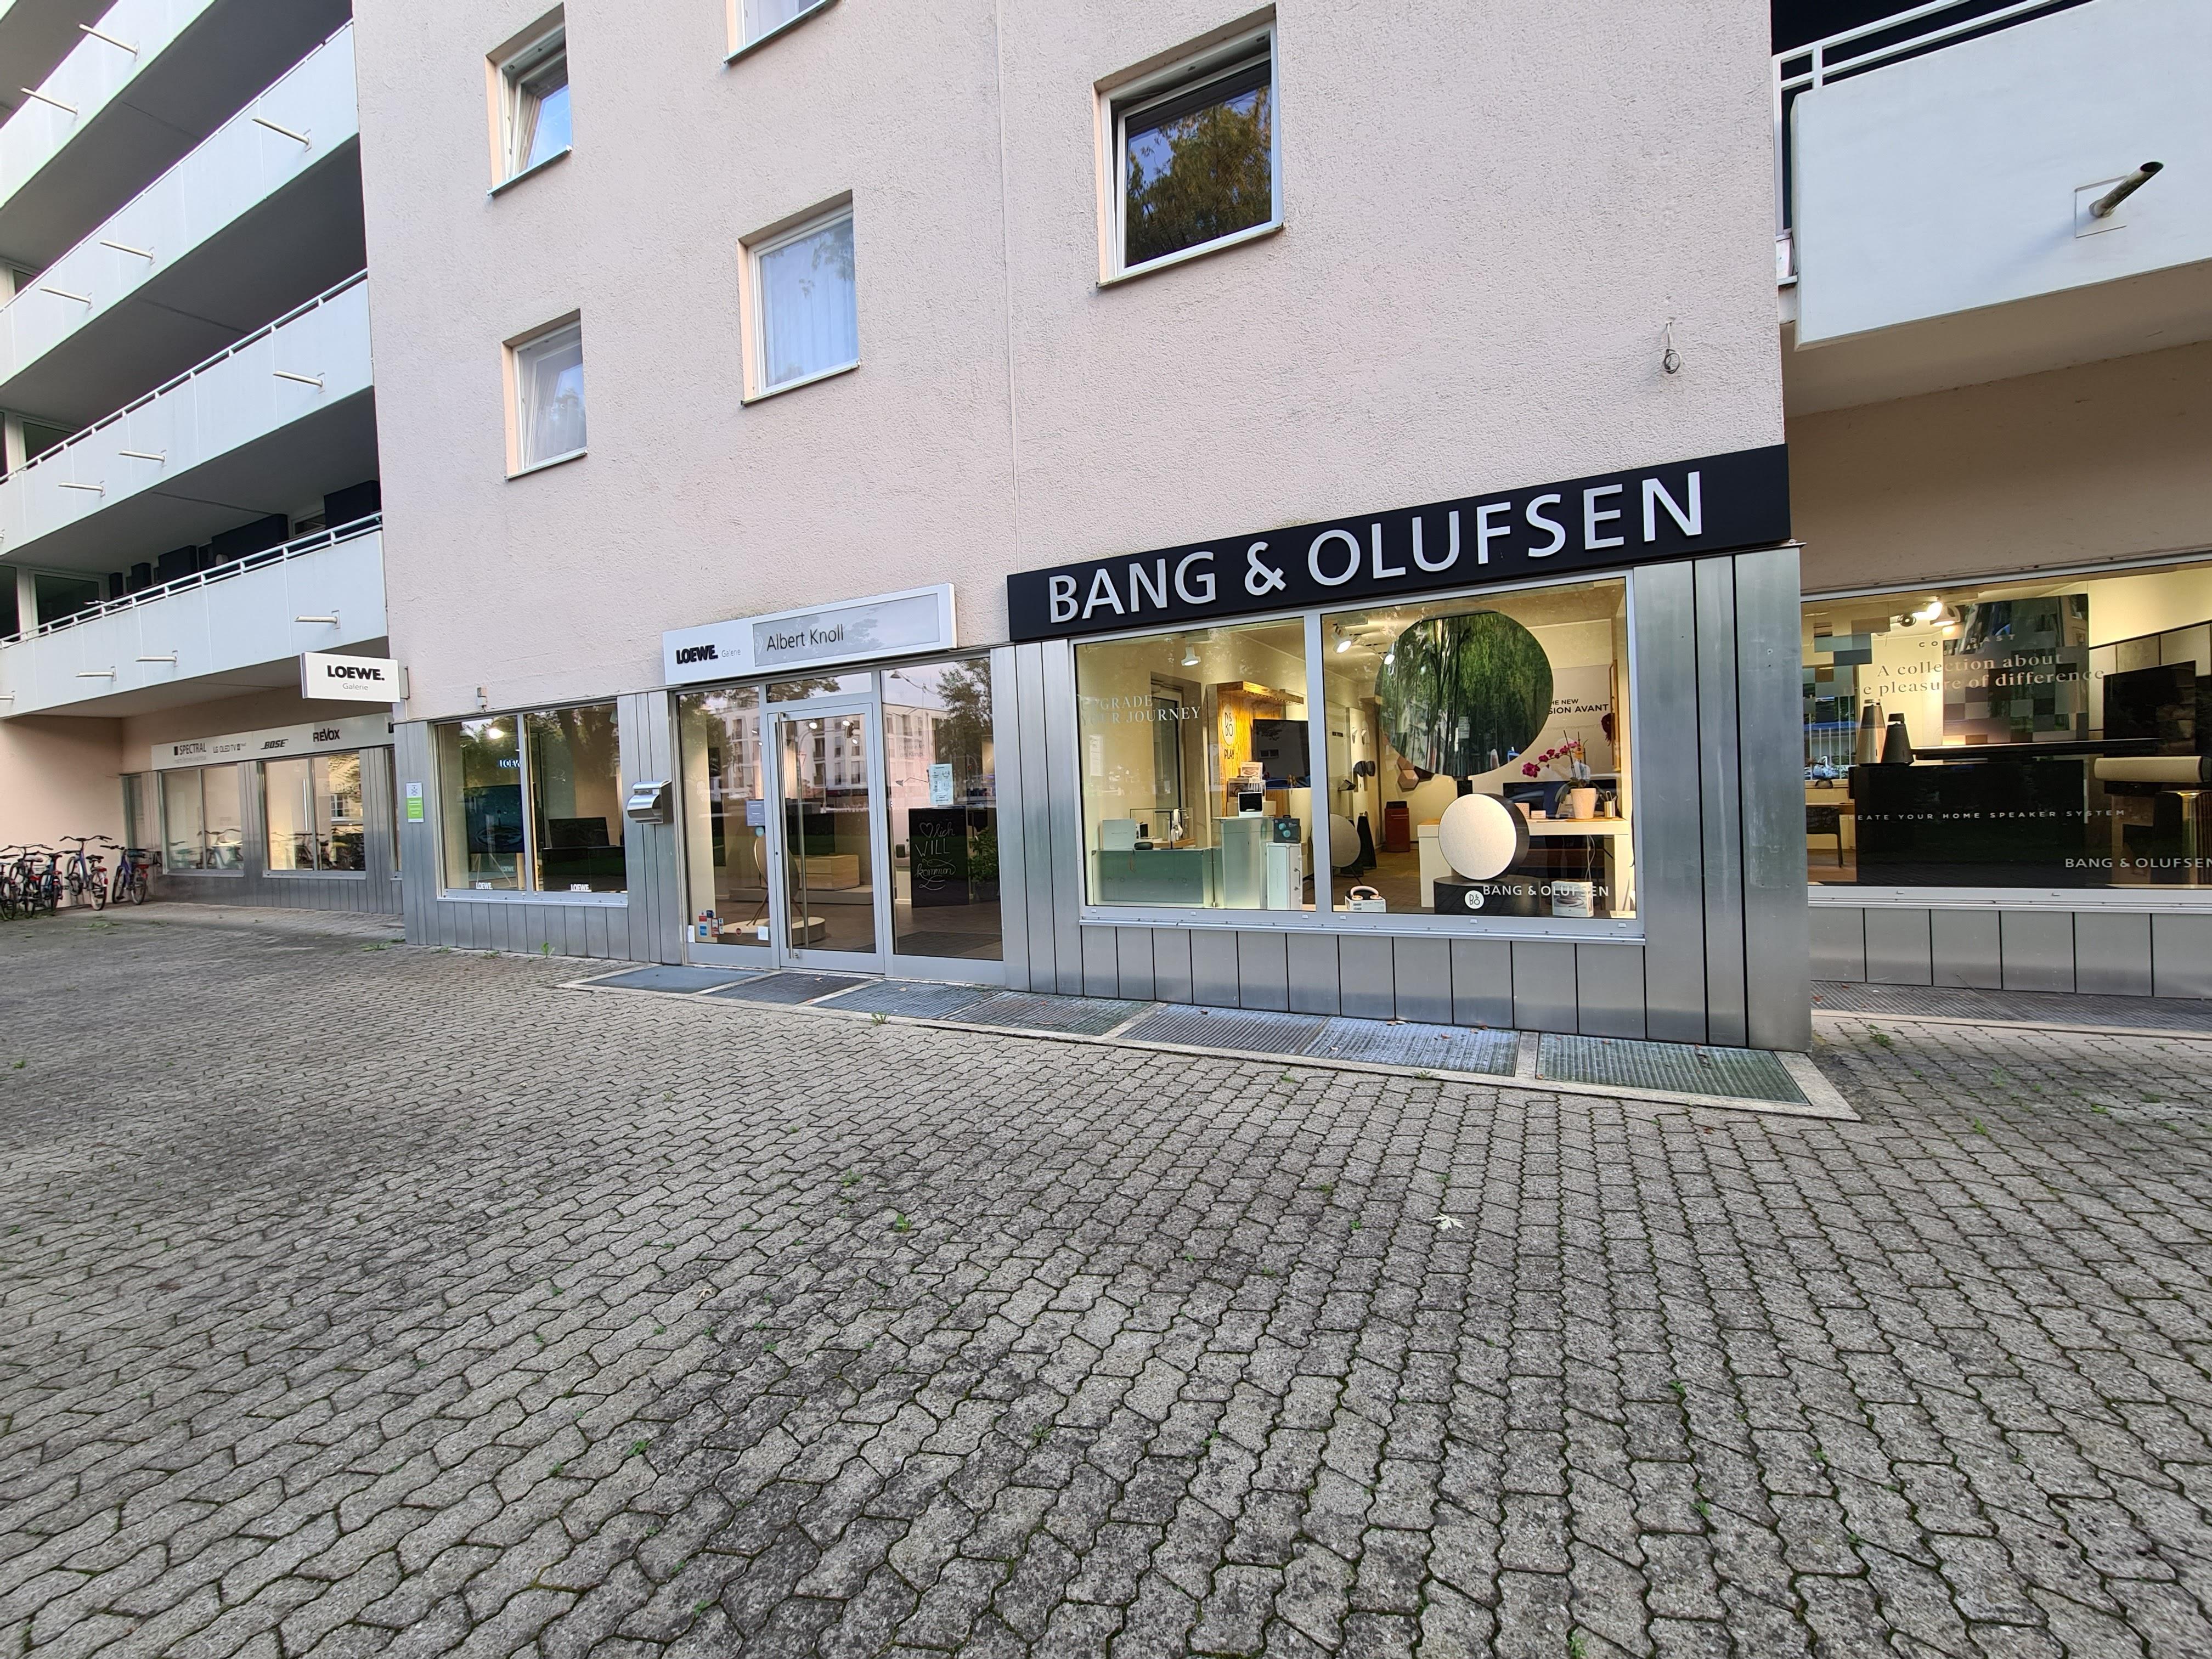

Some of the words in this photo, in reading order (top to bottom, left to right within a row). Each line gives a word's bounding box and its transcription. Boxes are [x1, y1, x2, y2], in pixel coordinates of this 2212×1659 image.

[1048, 550, 1216, 624] BANG
[1244, 541, 1288, 596] &
[1307, 470, 1702, 586] OLUFSEN
[721, 648, 741, 658] Galerie
[766, 632, 805, 652] Albert
[809, 624, 844, 645] Knoll
[1918, 633, 2015, 648] CORAST
[1877, 665, 1890, 677] A
[1897, 657, 1995, 676] collection
[2002, 652, 2062, 668] about
[1879, 678, 1962, 697] pleasure
[1968, 674, 1990, 689] of
[1995, 668, 2105, 688] difference
[1126, 706, 1201, 724] JOURNEY
[1575, 703, 1609, 713] AVANT
[179, 743, 207, 755] SPECTRAL
[261, 739, 289, 750] BOSE
[1224, 748, 1235, 760] PLAY
[915, 838, 951, 857] WILL
[2064, 857, 2113, 868] BANG
[2119, 858, 2131, 868] &
[1482, 885, 1522, 896] BANG
[1527, 885, 1537, 896] &
[1540, 885, 1610, 897] OLUFSEN
